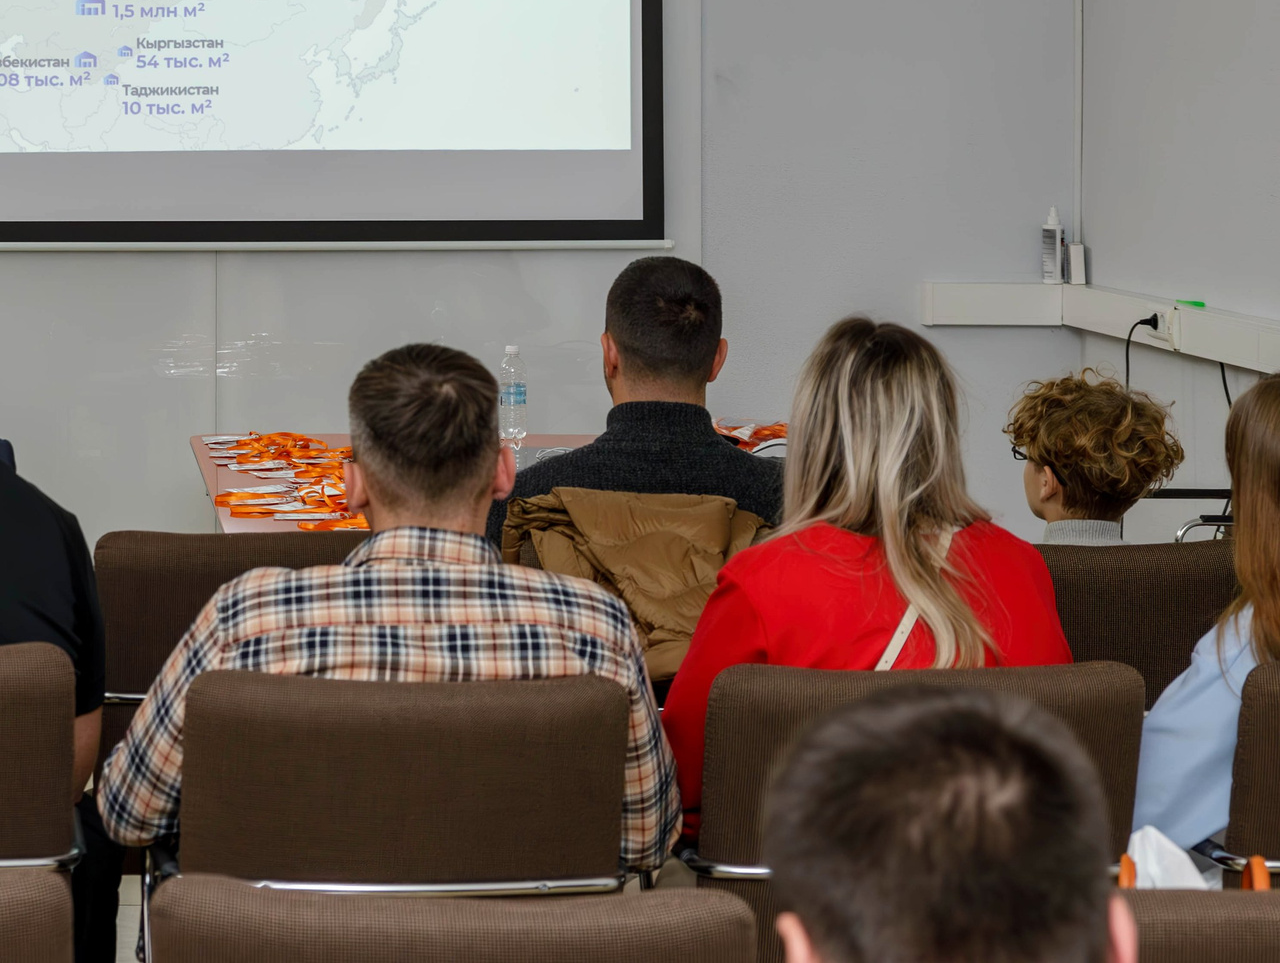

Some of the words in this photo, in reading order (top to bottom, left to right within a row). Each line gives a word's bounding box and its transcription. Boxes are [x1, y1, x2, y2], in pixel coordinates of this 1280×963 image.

[112, 4, 135, 19] 1,5
[140, 6, 178, 18] млн
[136, 37, 224, 52] Кыргызстан
[136, 54, 161, 68] 54
[165, 55, 204, 68] тыс.
[24, 75, 65, 87] тыс.
[122, 84, 220, 98] Таджикистан
[122, 101, 141, 115] 10
[146, 103, 185, 115] тыс.
